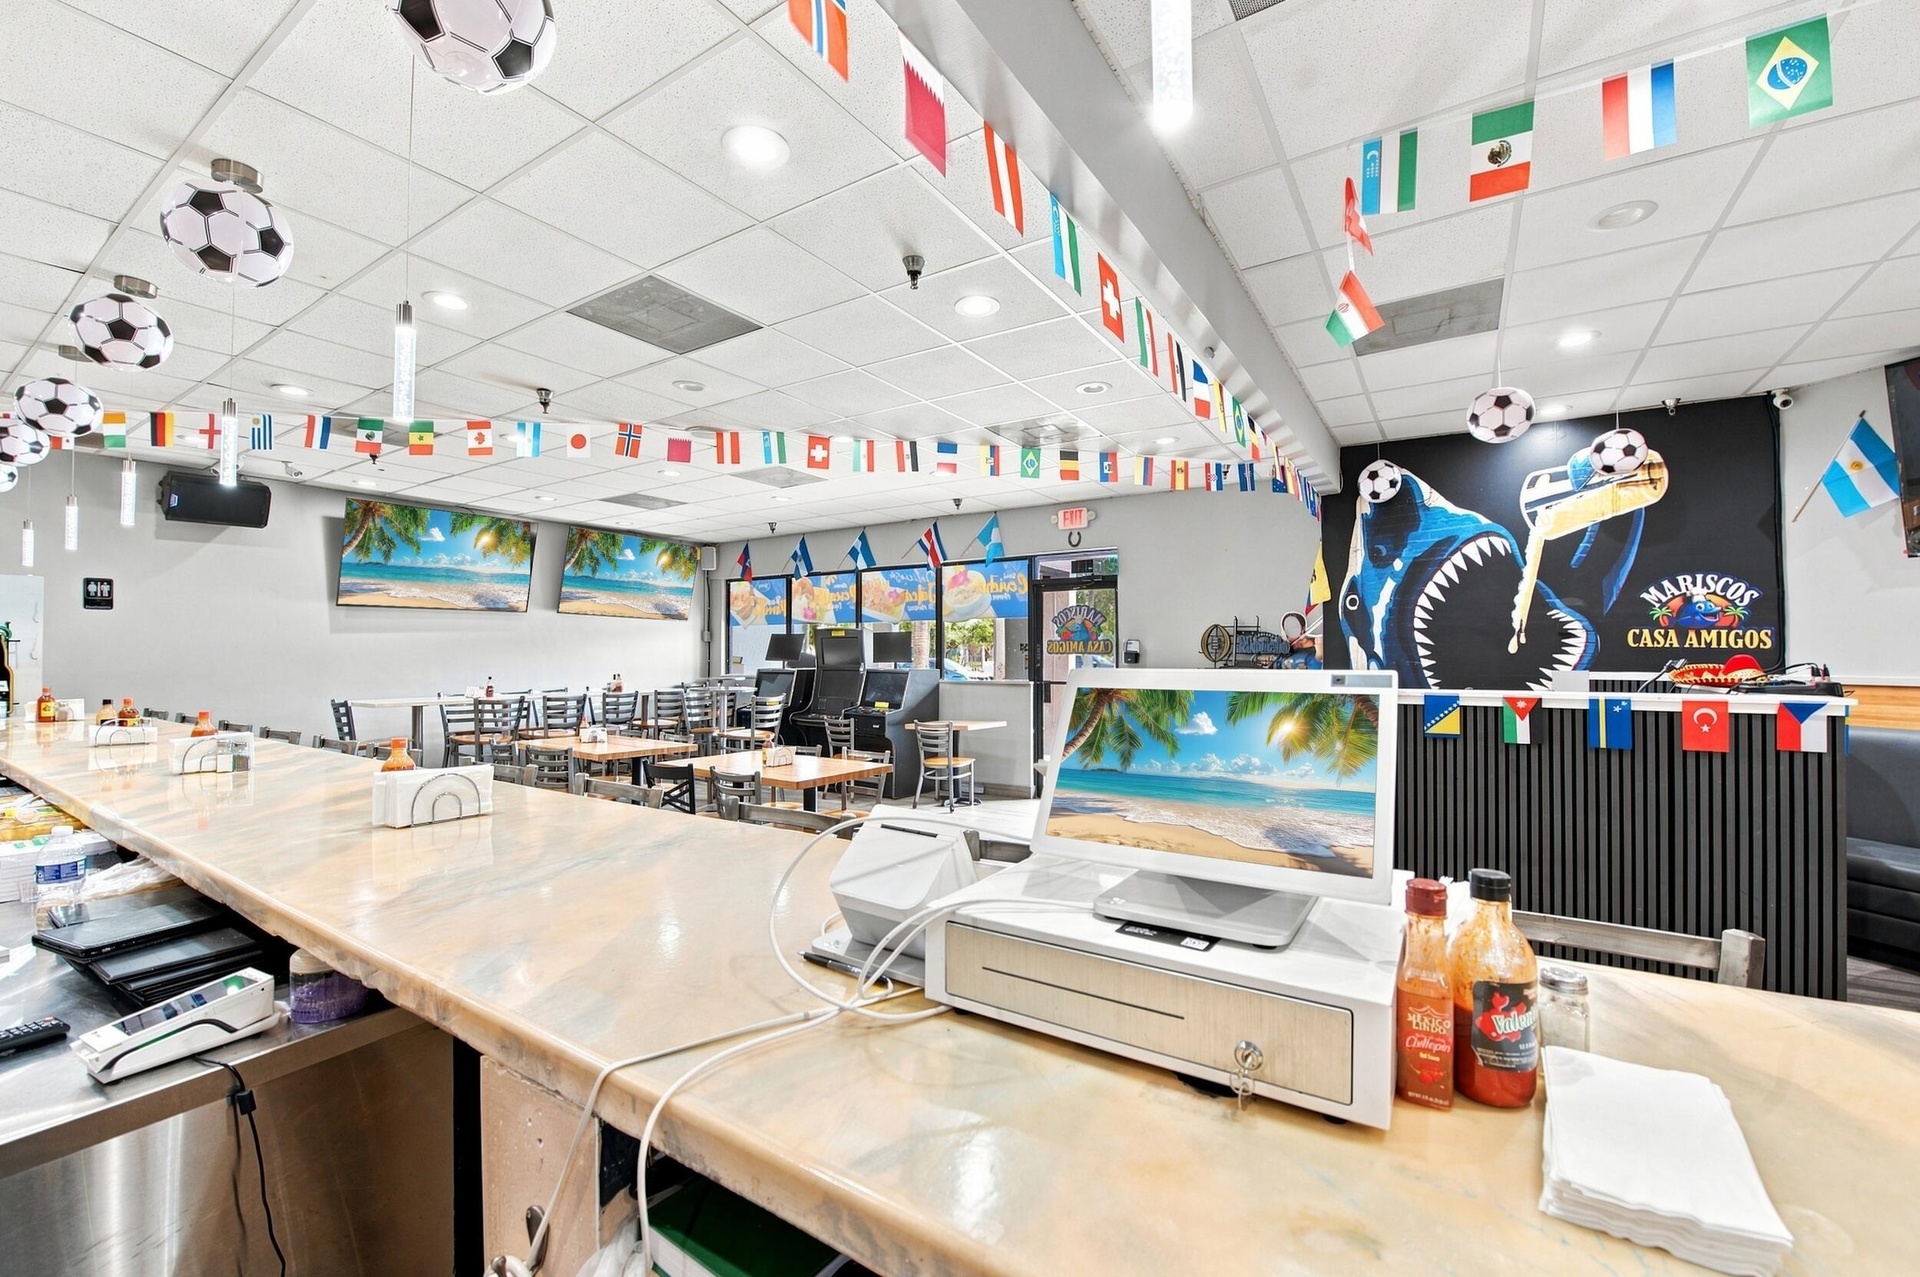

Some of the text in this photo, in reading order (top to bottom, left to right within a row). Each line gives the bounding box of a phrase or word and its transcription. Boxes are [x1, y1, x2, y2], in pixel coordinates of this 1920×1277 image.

[1063, 509, 1083, 527] EXIT
[1640, 574, 1759, 608] MARISCOS
[1627, 628, 1772, 649] CASA AMIGOS
[1407, 1012, 1451, 1029] MEXICO
[1412, 1020, 1447, 1034] LINDO
